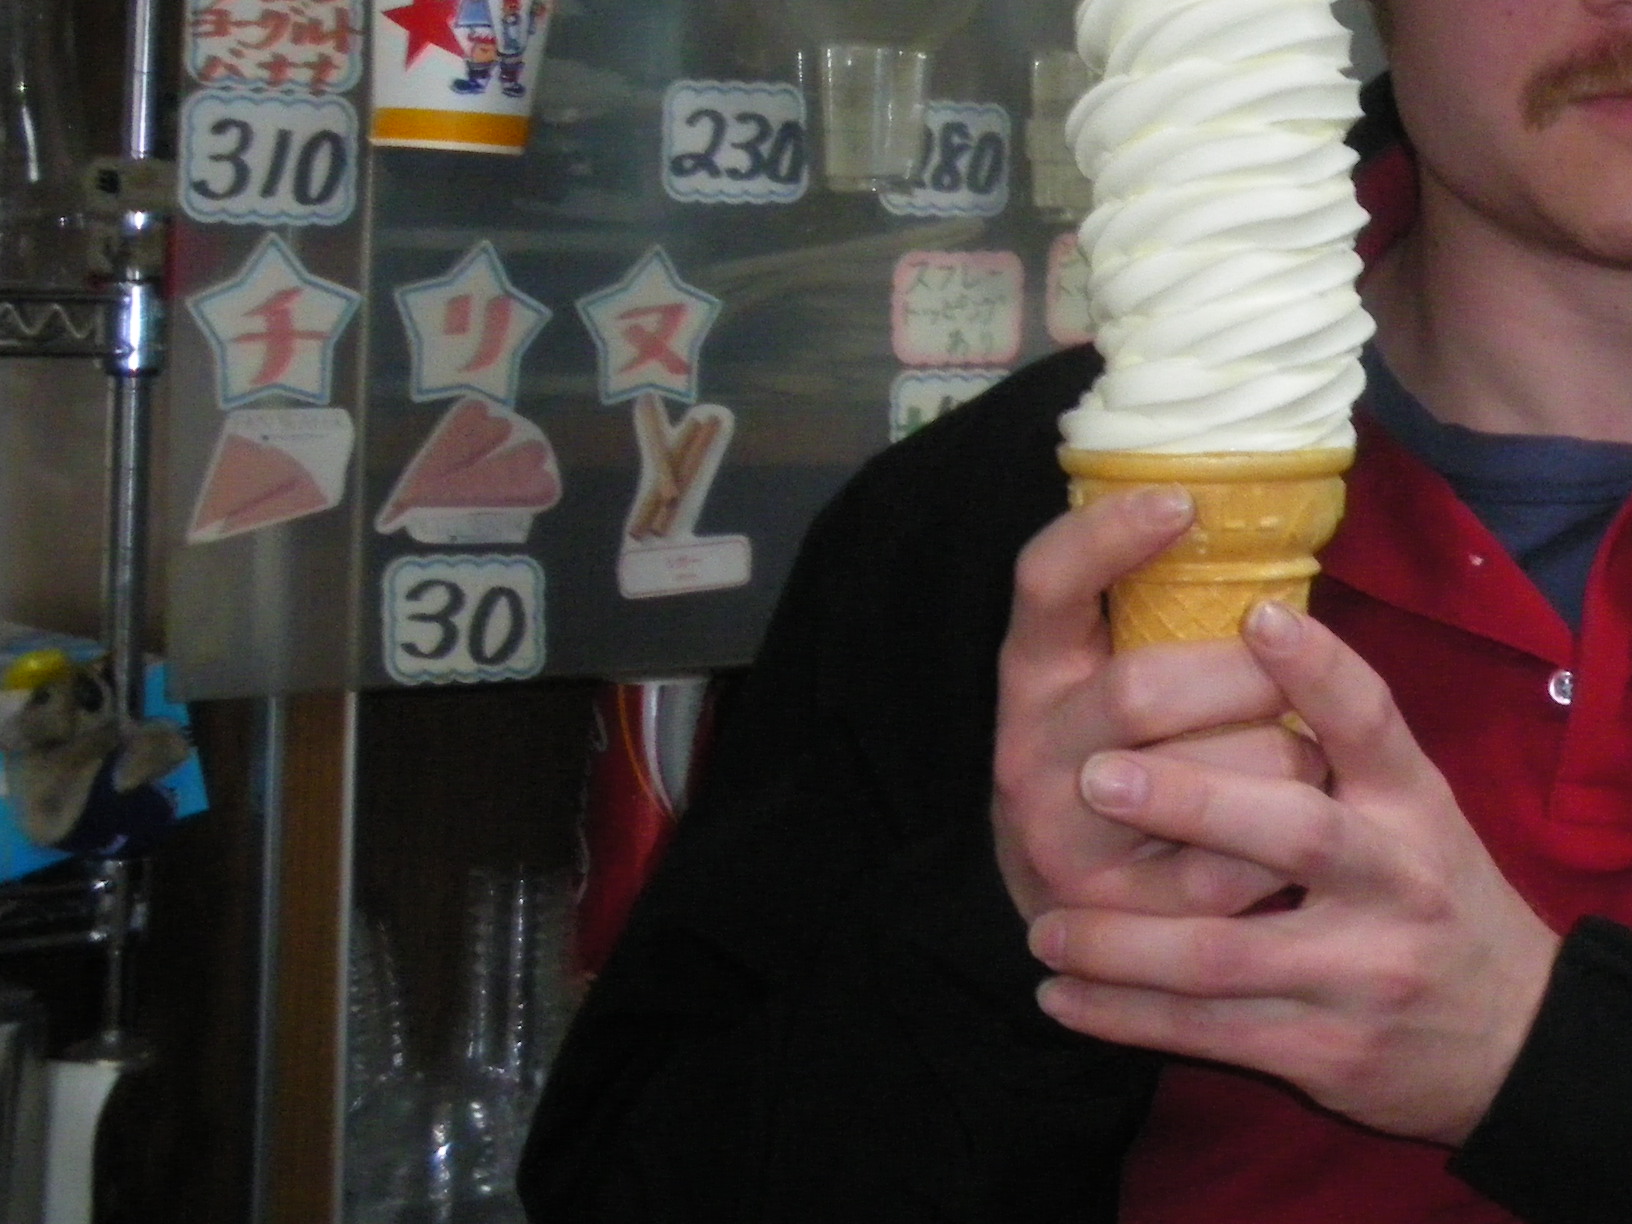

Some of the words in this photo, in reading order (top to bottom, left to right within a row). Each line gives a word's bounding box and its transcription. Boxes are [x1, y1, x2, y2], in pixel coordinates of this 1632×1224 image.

[192, 117, 347, 207] 310
[670, 109, 804, 184] 230
[399, 578, 527, 666] 30
